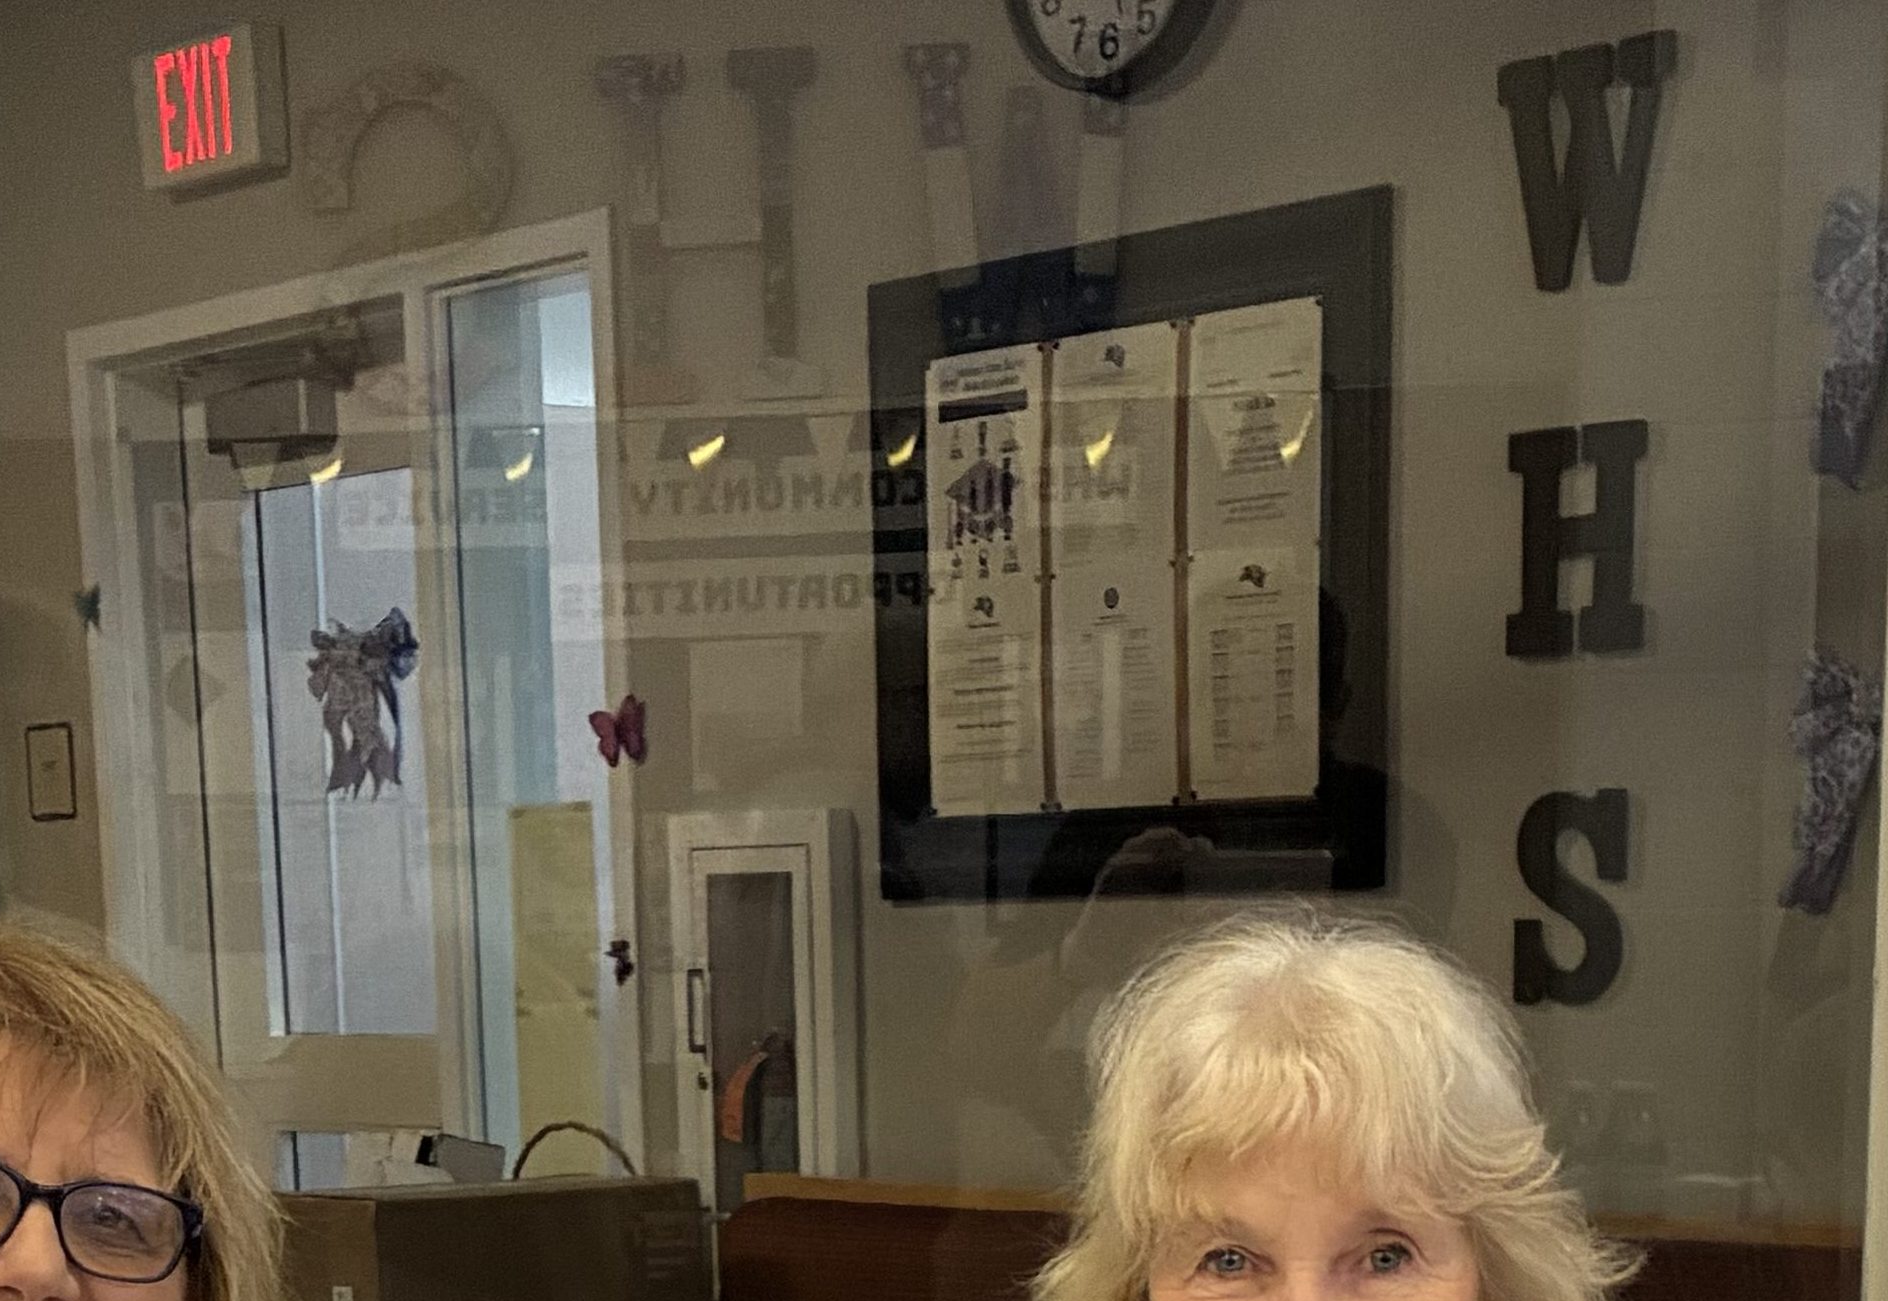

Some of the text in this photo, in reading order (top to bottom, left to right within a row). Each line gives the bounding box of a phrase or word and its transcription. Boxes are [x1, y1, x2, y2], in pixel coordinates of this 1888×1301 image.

[1069, 15, 1086, 54] 7
[1099, 22, 1119, 61] 6
[154, 35, 233, 172] EXIT
